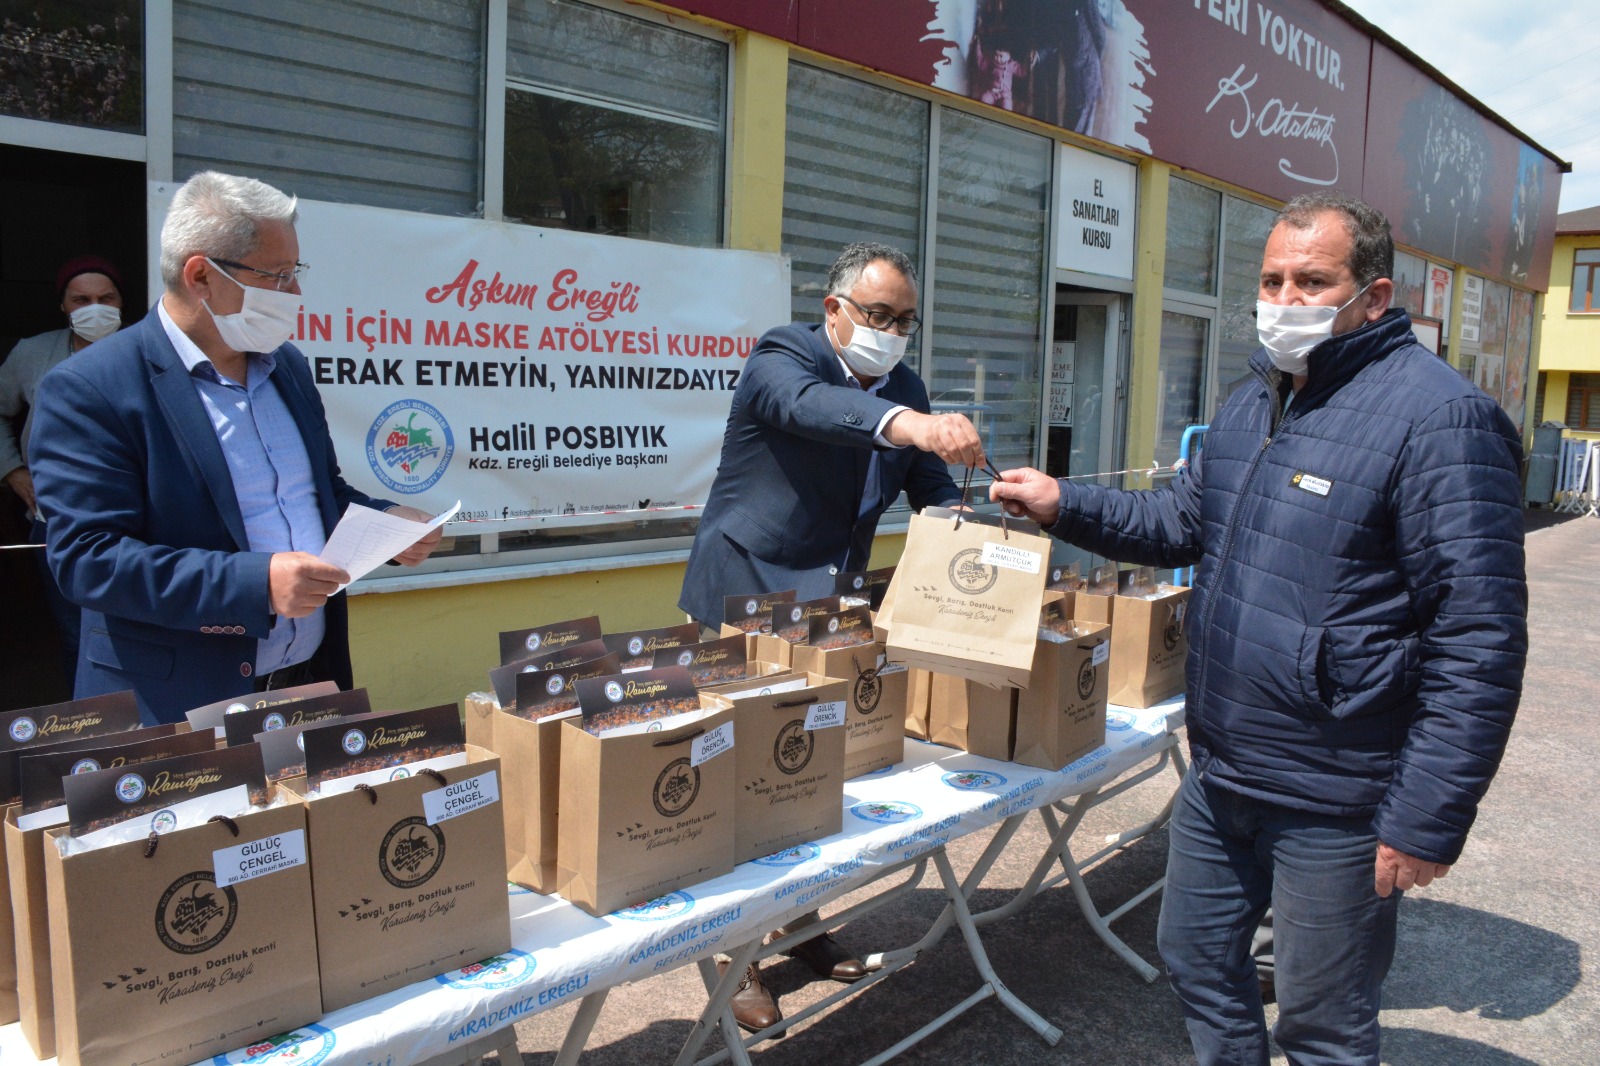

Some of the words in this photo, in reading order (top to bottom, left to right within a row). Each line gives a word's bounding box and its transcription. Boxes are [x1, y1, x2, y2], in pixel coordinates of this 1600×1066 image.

[1257, 3, 1345, 91] YOKTUR.
[1094, 179, 1104, 198] EL
[1073, 199, 1120, 227] SANATLARI
[1082, 227, 1111, 250] KURSU
[425, 259, 539, 311] Aşkım
[547, 268, 641, 322] Ereğli
[288, 304, 332, 341] İN
[346, 307, 412, 352] İÇİN
[424, 319, 529, 350] MASKE
[538, 321, 659, 355] ATÖLYESİ
[304, 356, 405, 386] ERAK
[416, 356, 556, 392] ETMEYİN,
[469, 422, 536, 451] Halil
[545, 425, 668, 450] POSBIYIK
[469, 457, 502, 469] Kdz.
[507, 454, 549, 471] Ereğli
[553, 452, 611, 469] Belediye
[616, 453, 668, 469] Başkanı
[969, 600, 996, 610] Dostluk
[147, 770, 222, 797] Ramazan
[445, 778, 480, 797] GÜLÜÇ
[444, 790, 484, 811] ÇENGEL
[676, 816, 702, 829] Dostluk
[241, 837, 282, 856] GÜLÜÇ
[239, 850, 287, 873] ÇENGEL
[278, 857, 299, 868] MASKE
[356, 906, 385, 922] Sevgi,
[388, 898, 415, 912] Barış,
[418, 886, 453, 903] Dostluk
[455, 880, 475, 892] Kenti
[379, 909, 427, 933] Karadeniz
[629, 925, 699, 965] KARADENİZ
[125, 975, 163, 994] Sevgi,
[168, 966, 202, 982] Barış,
[206, 950, 249, 970] Dostluk
[251, 941, 277, 956] Kenti
[157, 976, 217, 1005] Karadeniz
[219, 963, 254, 986] Ereğli
[447, 995, 534, 1046] KARADENİZ
[537, 970, 590, 1006] EREĞLİ
